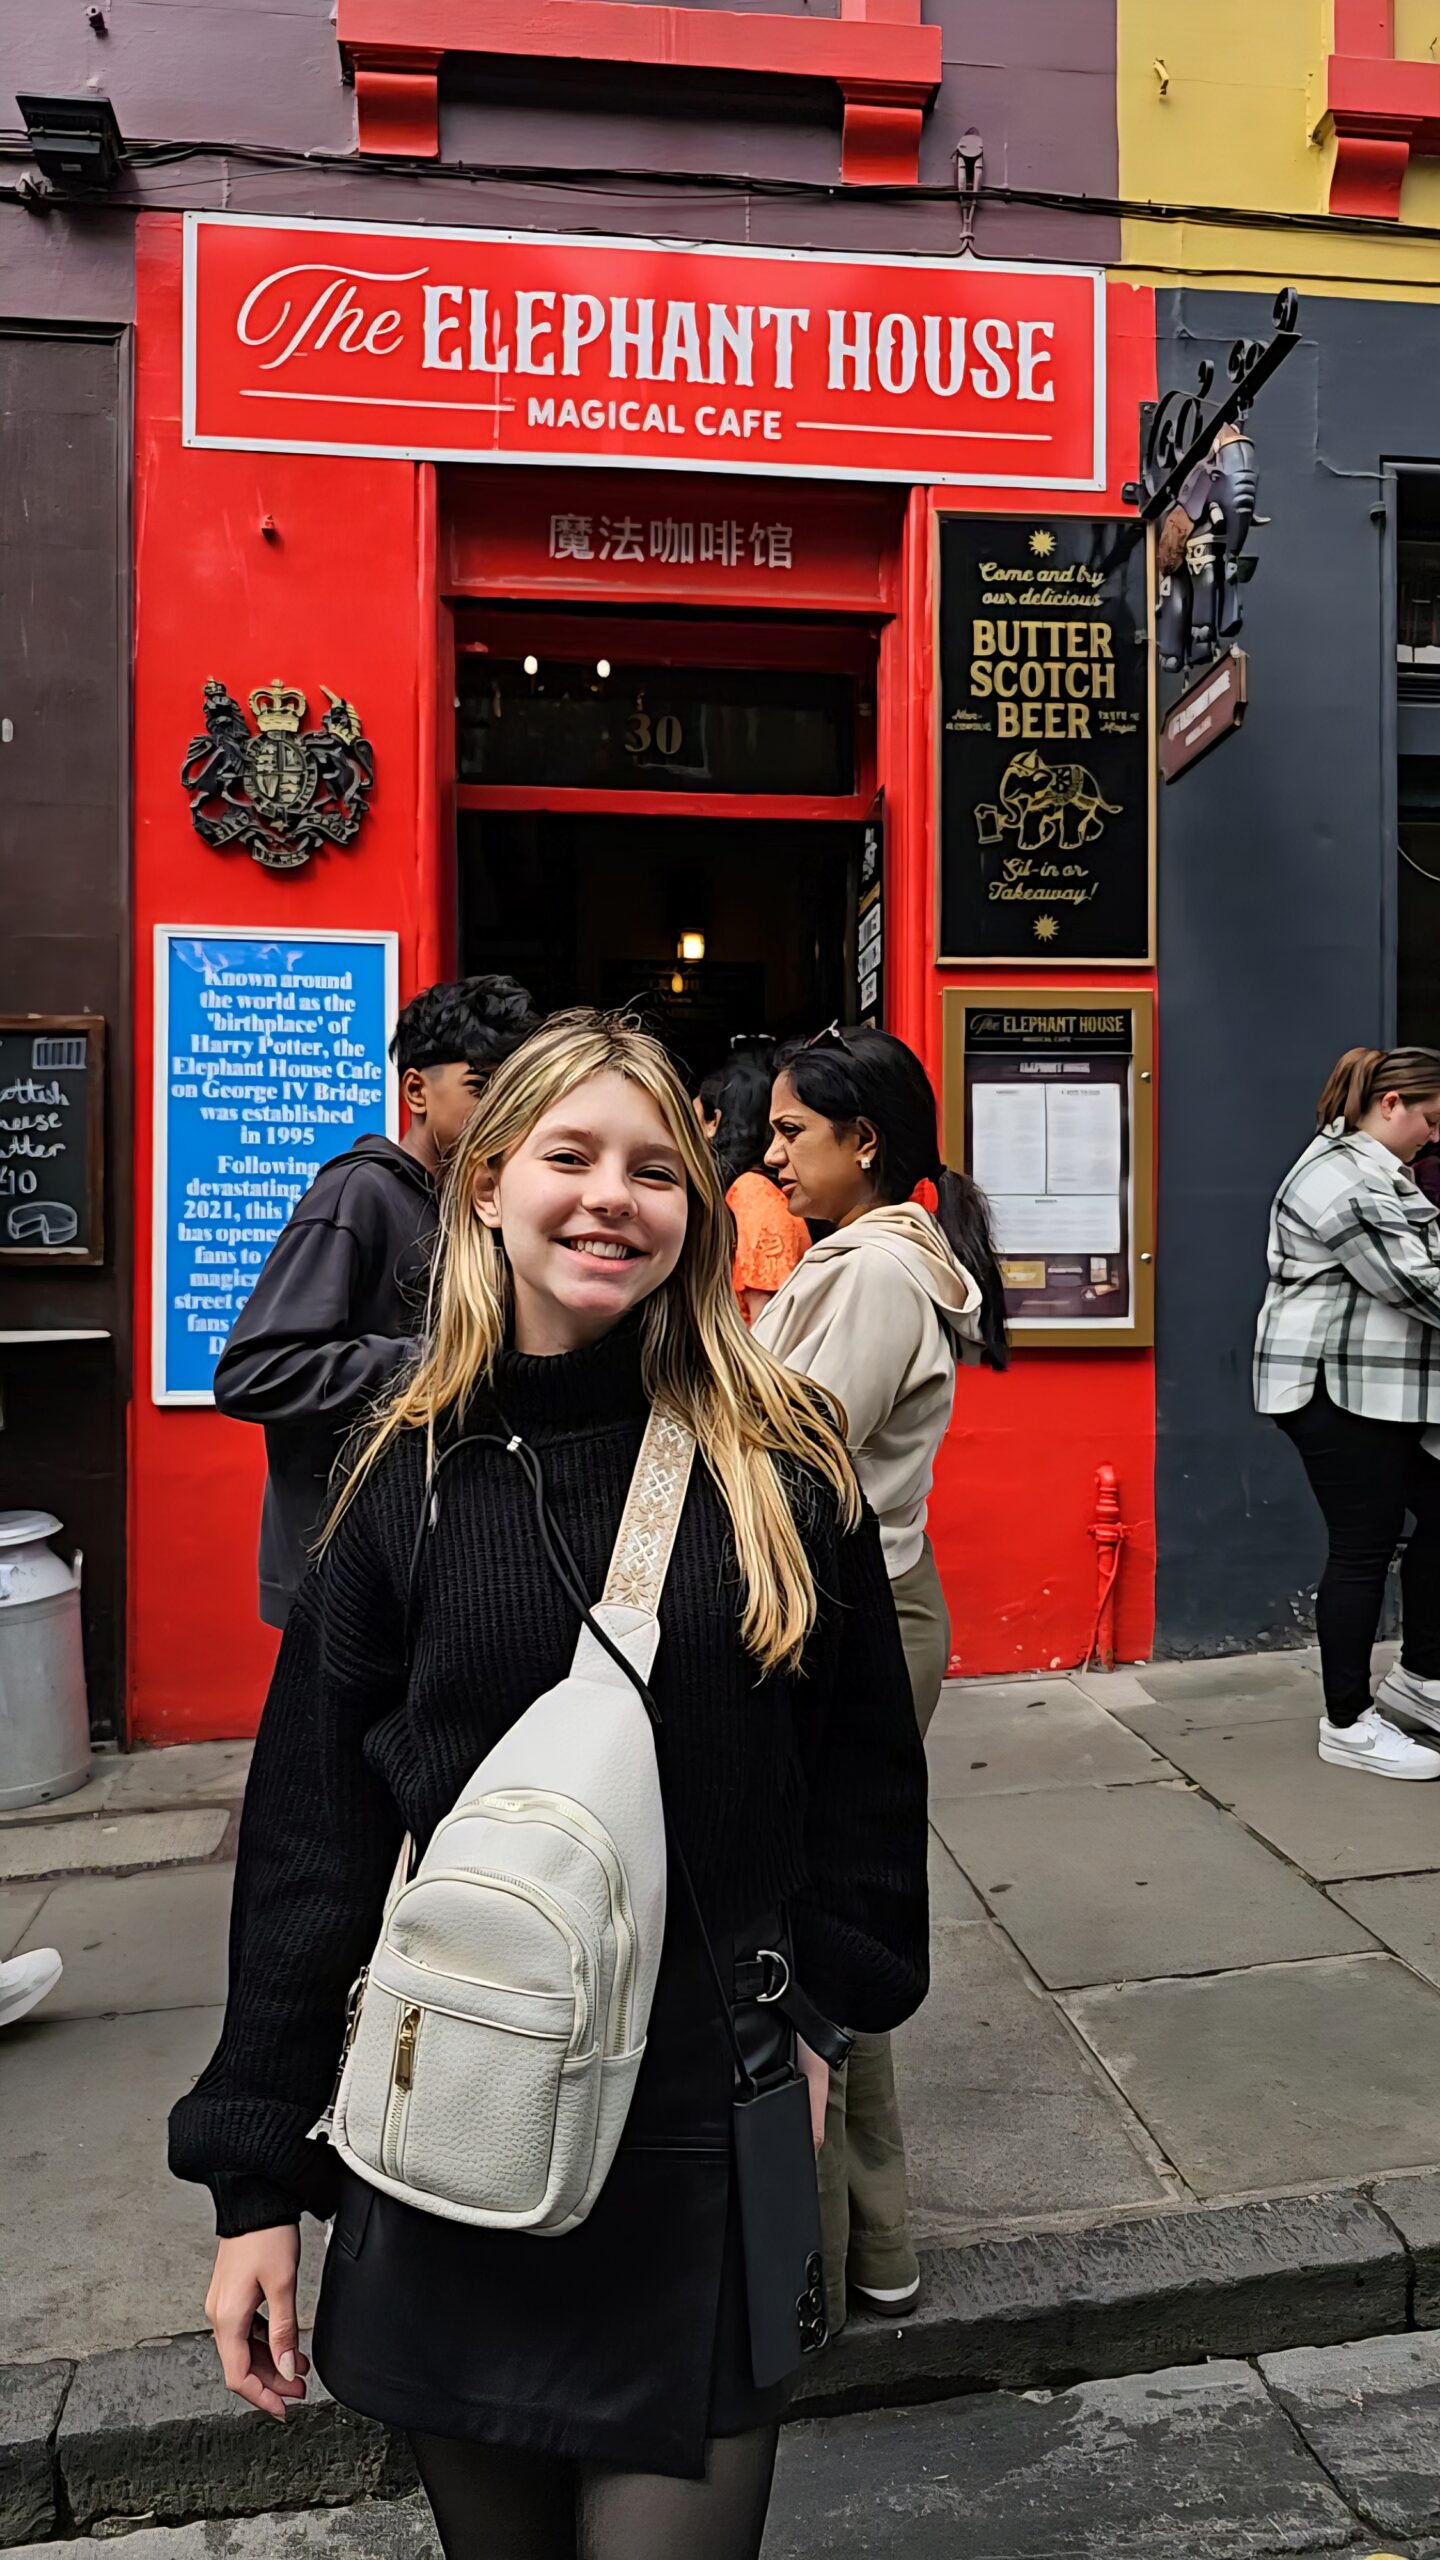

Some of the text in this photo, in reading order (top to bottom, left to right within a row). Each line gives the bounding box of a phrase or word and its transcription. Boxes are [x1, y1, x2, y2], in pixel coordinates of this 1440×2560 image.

[237, 264, 1055, 402] The ELEPHANT HOUSE
[527, 397, 782, 440] MAGICAL CAFE
[549, 513, 793, 569] 魔法咖啡馆
[979, 562, 1106, 588] Come and try
[982, 587, 1104, 607] our delicious
[973, 619, 1114, 658] BUTTER
[970, 660, 1115, 699] SCOTCH
[997, 702, 1092, 739] BEER
[624, 713, 682, 754] 30
[1003, 858, 1089, 881] Sit-in or
[988, 881, 1099, 905] Takeaway!
[204, 969, 352, 990] Known around
[200, 990, 356, 1012] the world as the
[328, 1016, 352, 1034] of
[1003, 1016, 1077, 1033] ELEPHANT
[1079, 1016, 1125, 1033] HOUSE
[191, 1034, 365, 1059] Harry Potter, the
[172, 1056, 382, 1080] Elephant House Cafe
[0, 1078, 70, 1106] ottish
[171, 1080, 382, 1106] on George IV Bridge
[200, 1104, 354, 1124] was established
[240, 1124, 315, 1146] in 1995
[218, 1155, 320, 1179] Following
[186, 1177, 302, 1200] devastating
[183, 1200, 241, 1222] 2021,
[245, 1200, 282, 1219] this
[178, 1222, 283, 1247] has opene
[194, 1245, 237, 1264] fans
[241, 1248, 261, 1264] to
[174, 1293, 232, 1309] street
[187, 1313, 230, 1332] fans
